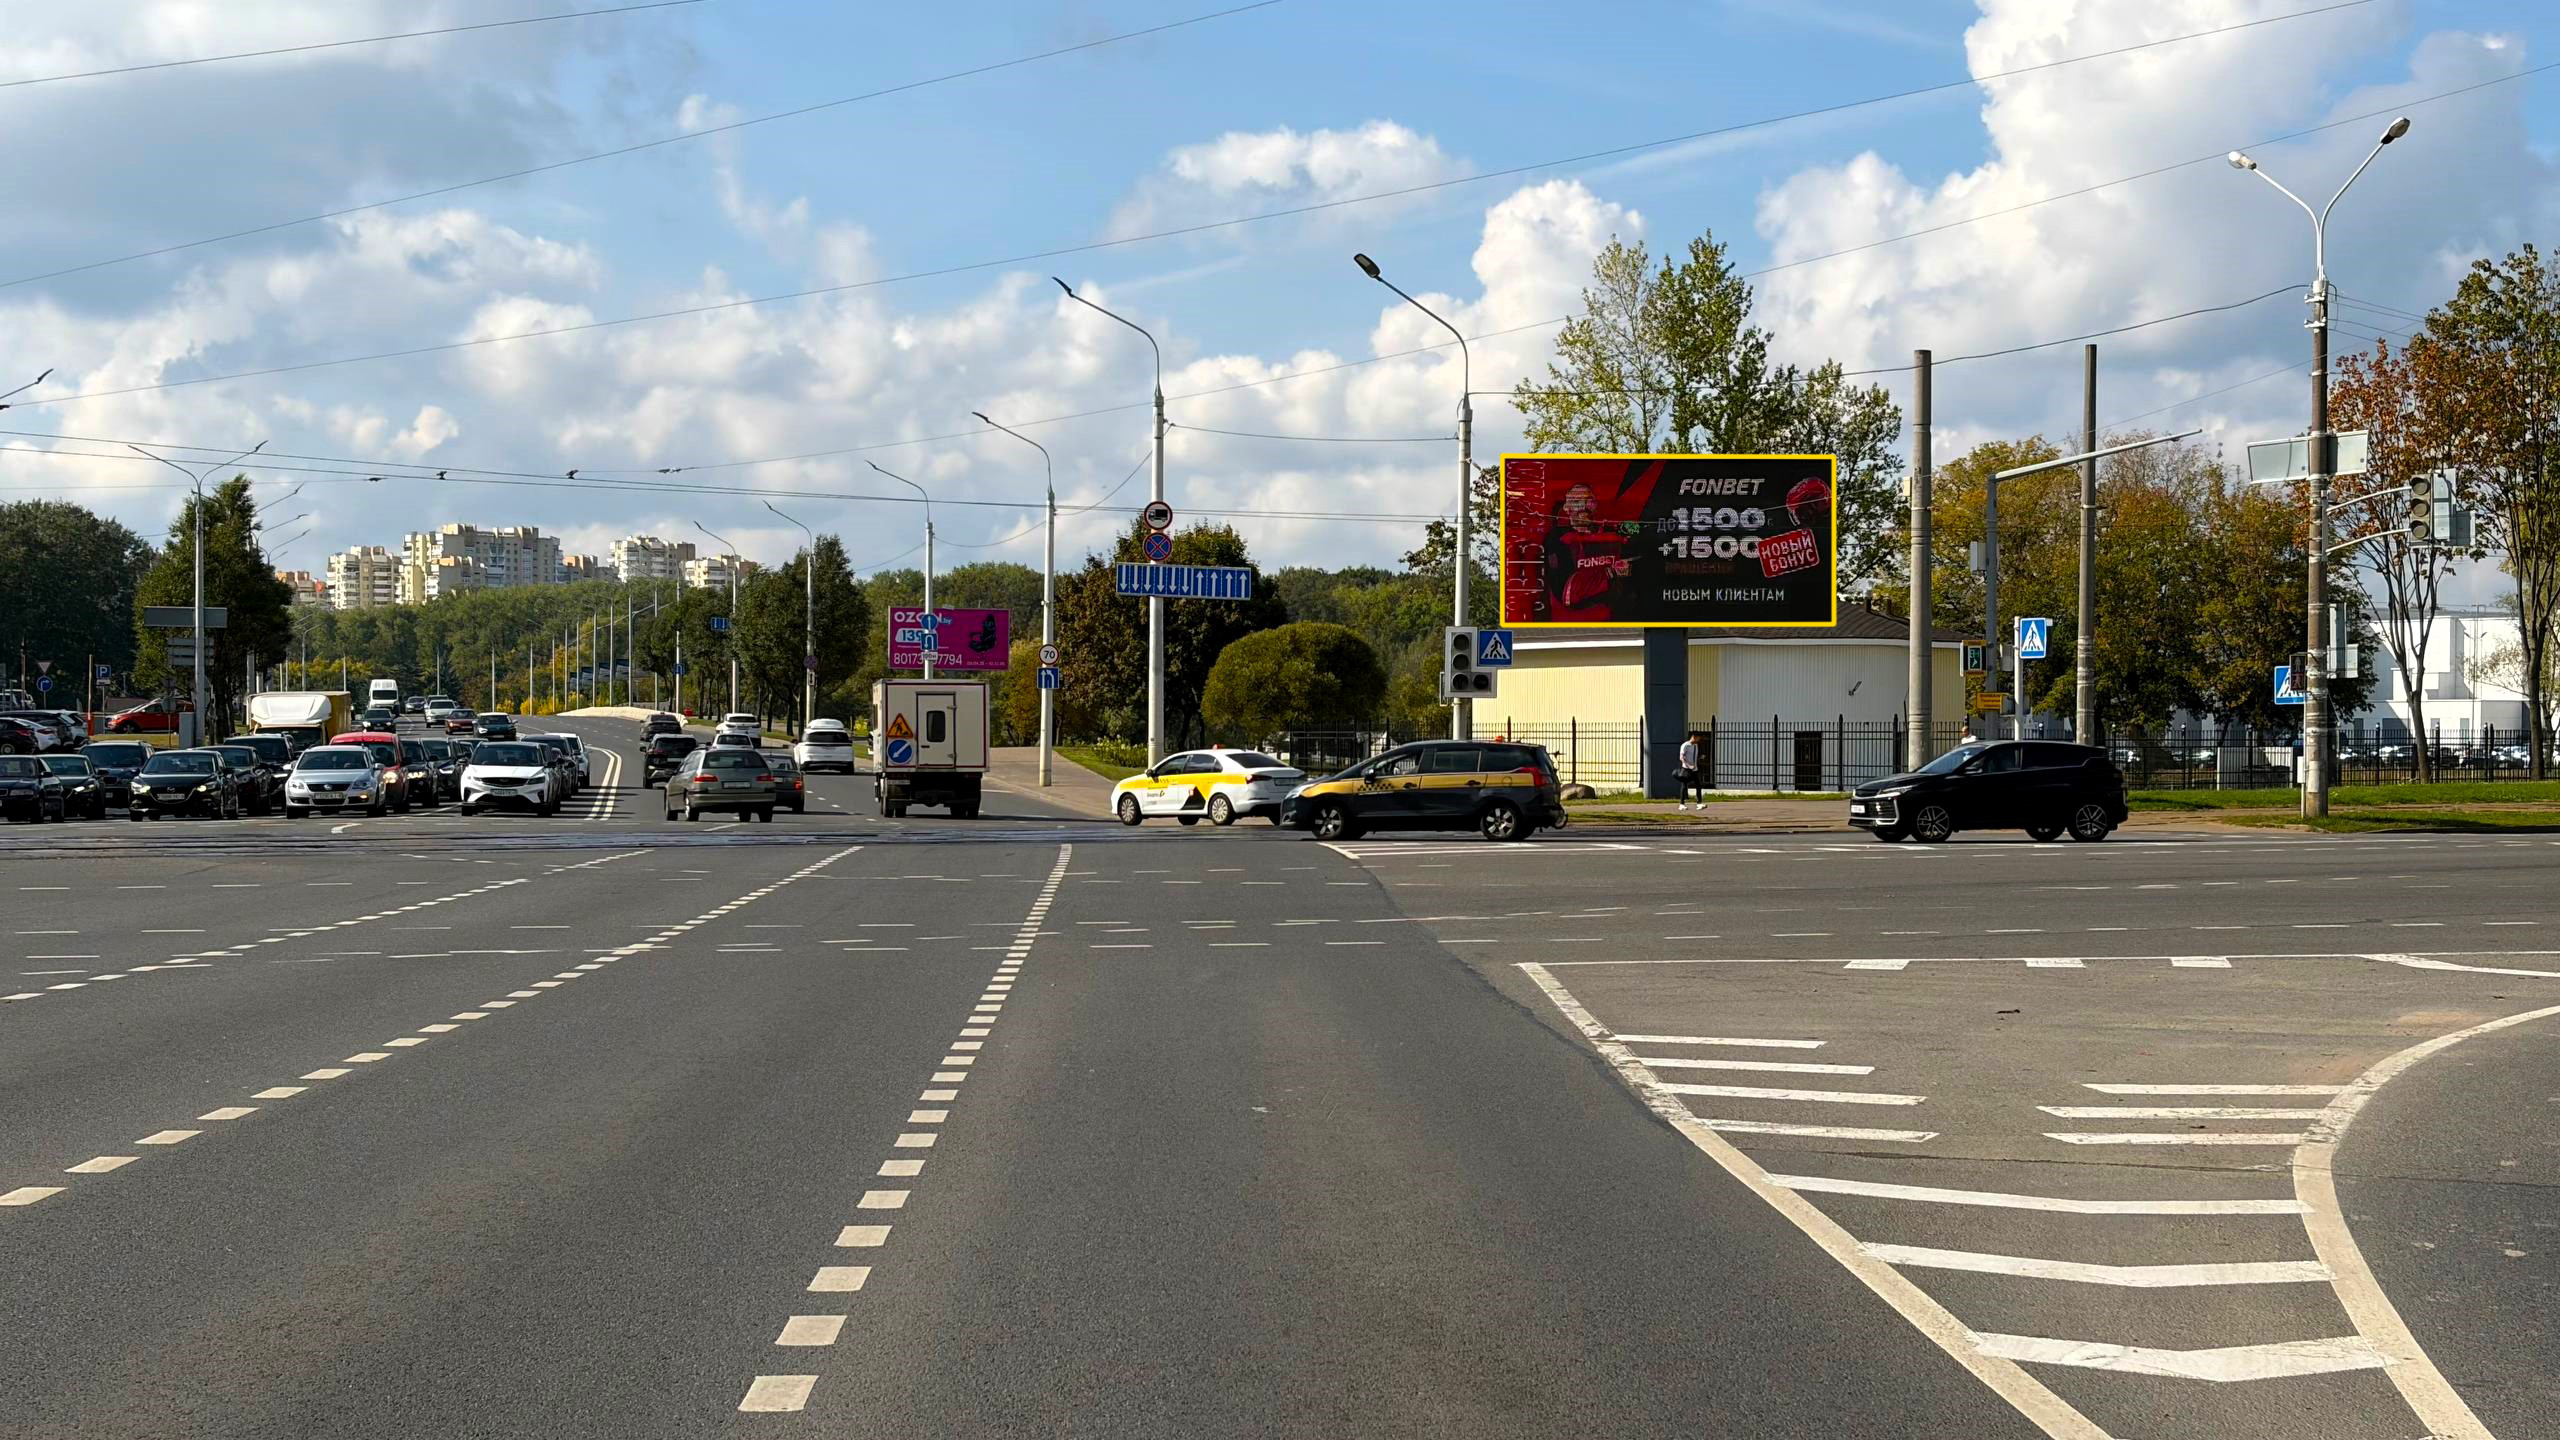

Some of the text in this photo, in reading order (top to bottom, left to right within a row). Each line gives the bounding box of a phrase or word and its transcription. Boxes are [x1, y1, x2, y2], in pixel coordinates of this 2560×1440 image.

[1679, 479, 1765, 495] FONBET
[1672, 508, 1765, 531] 1500
[1658, 536, 1761, 558] +1500
[1761, 530, 1812, 559] НОВЫЙ
[1577, 555, 1615, 568] FONBET
[1770, 549, 1815, 572] БОНУС
[1662, 588, 1784, 601] НОВЫМ КЛИЕНТАМ
[1044, 650, 1055, 659] 70
